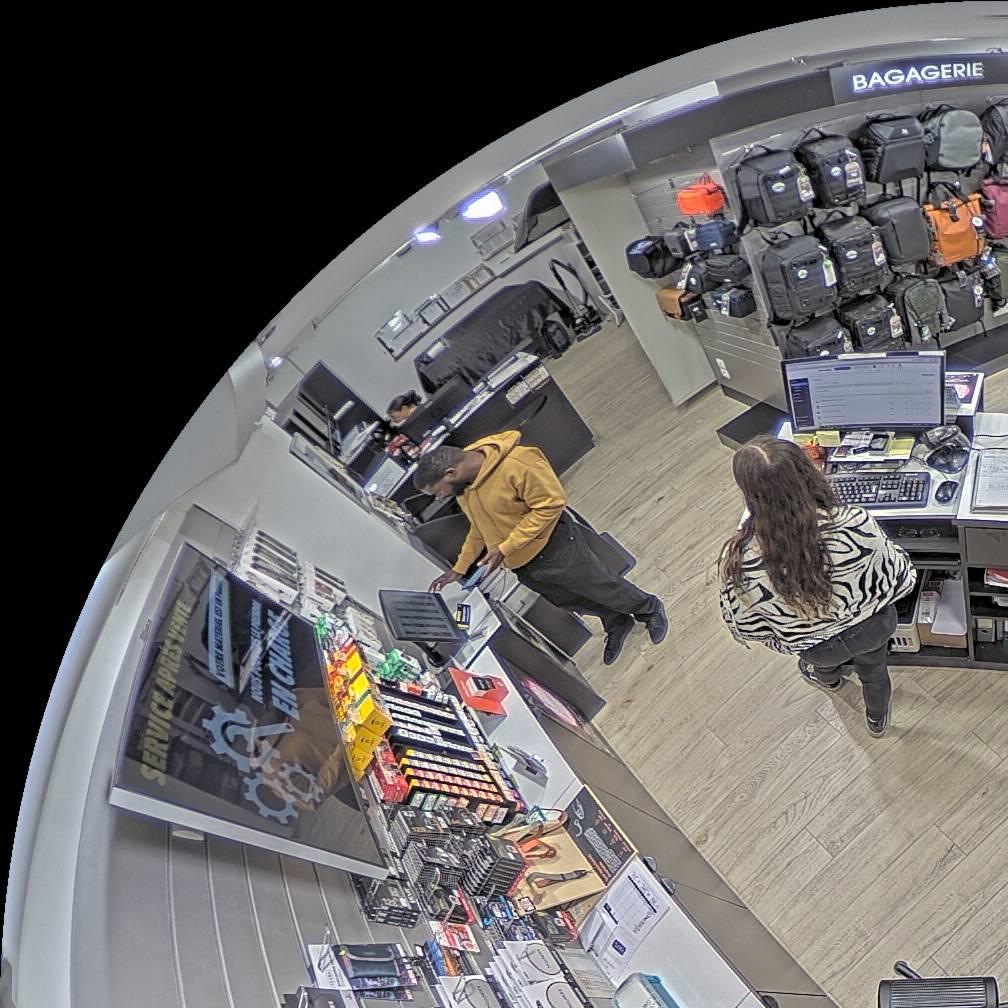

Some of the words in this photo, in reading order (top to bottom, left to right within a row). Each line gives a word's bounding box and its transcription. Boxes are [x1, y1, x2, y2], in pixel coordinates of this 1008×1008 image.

[851, 61, 984, 91] BAGAGERIE
[213, 649, 225, 677] VOTRE
[141, 691, 174, 786] SERVICE
[166, 598, 192, 644] VENTE
[271, 680, 299, 721] EN
